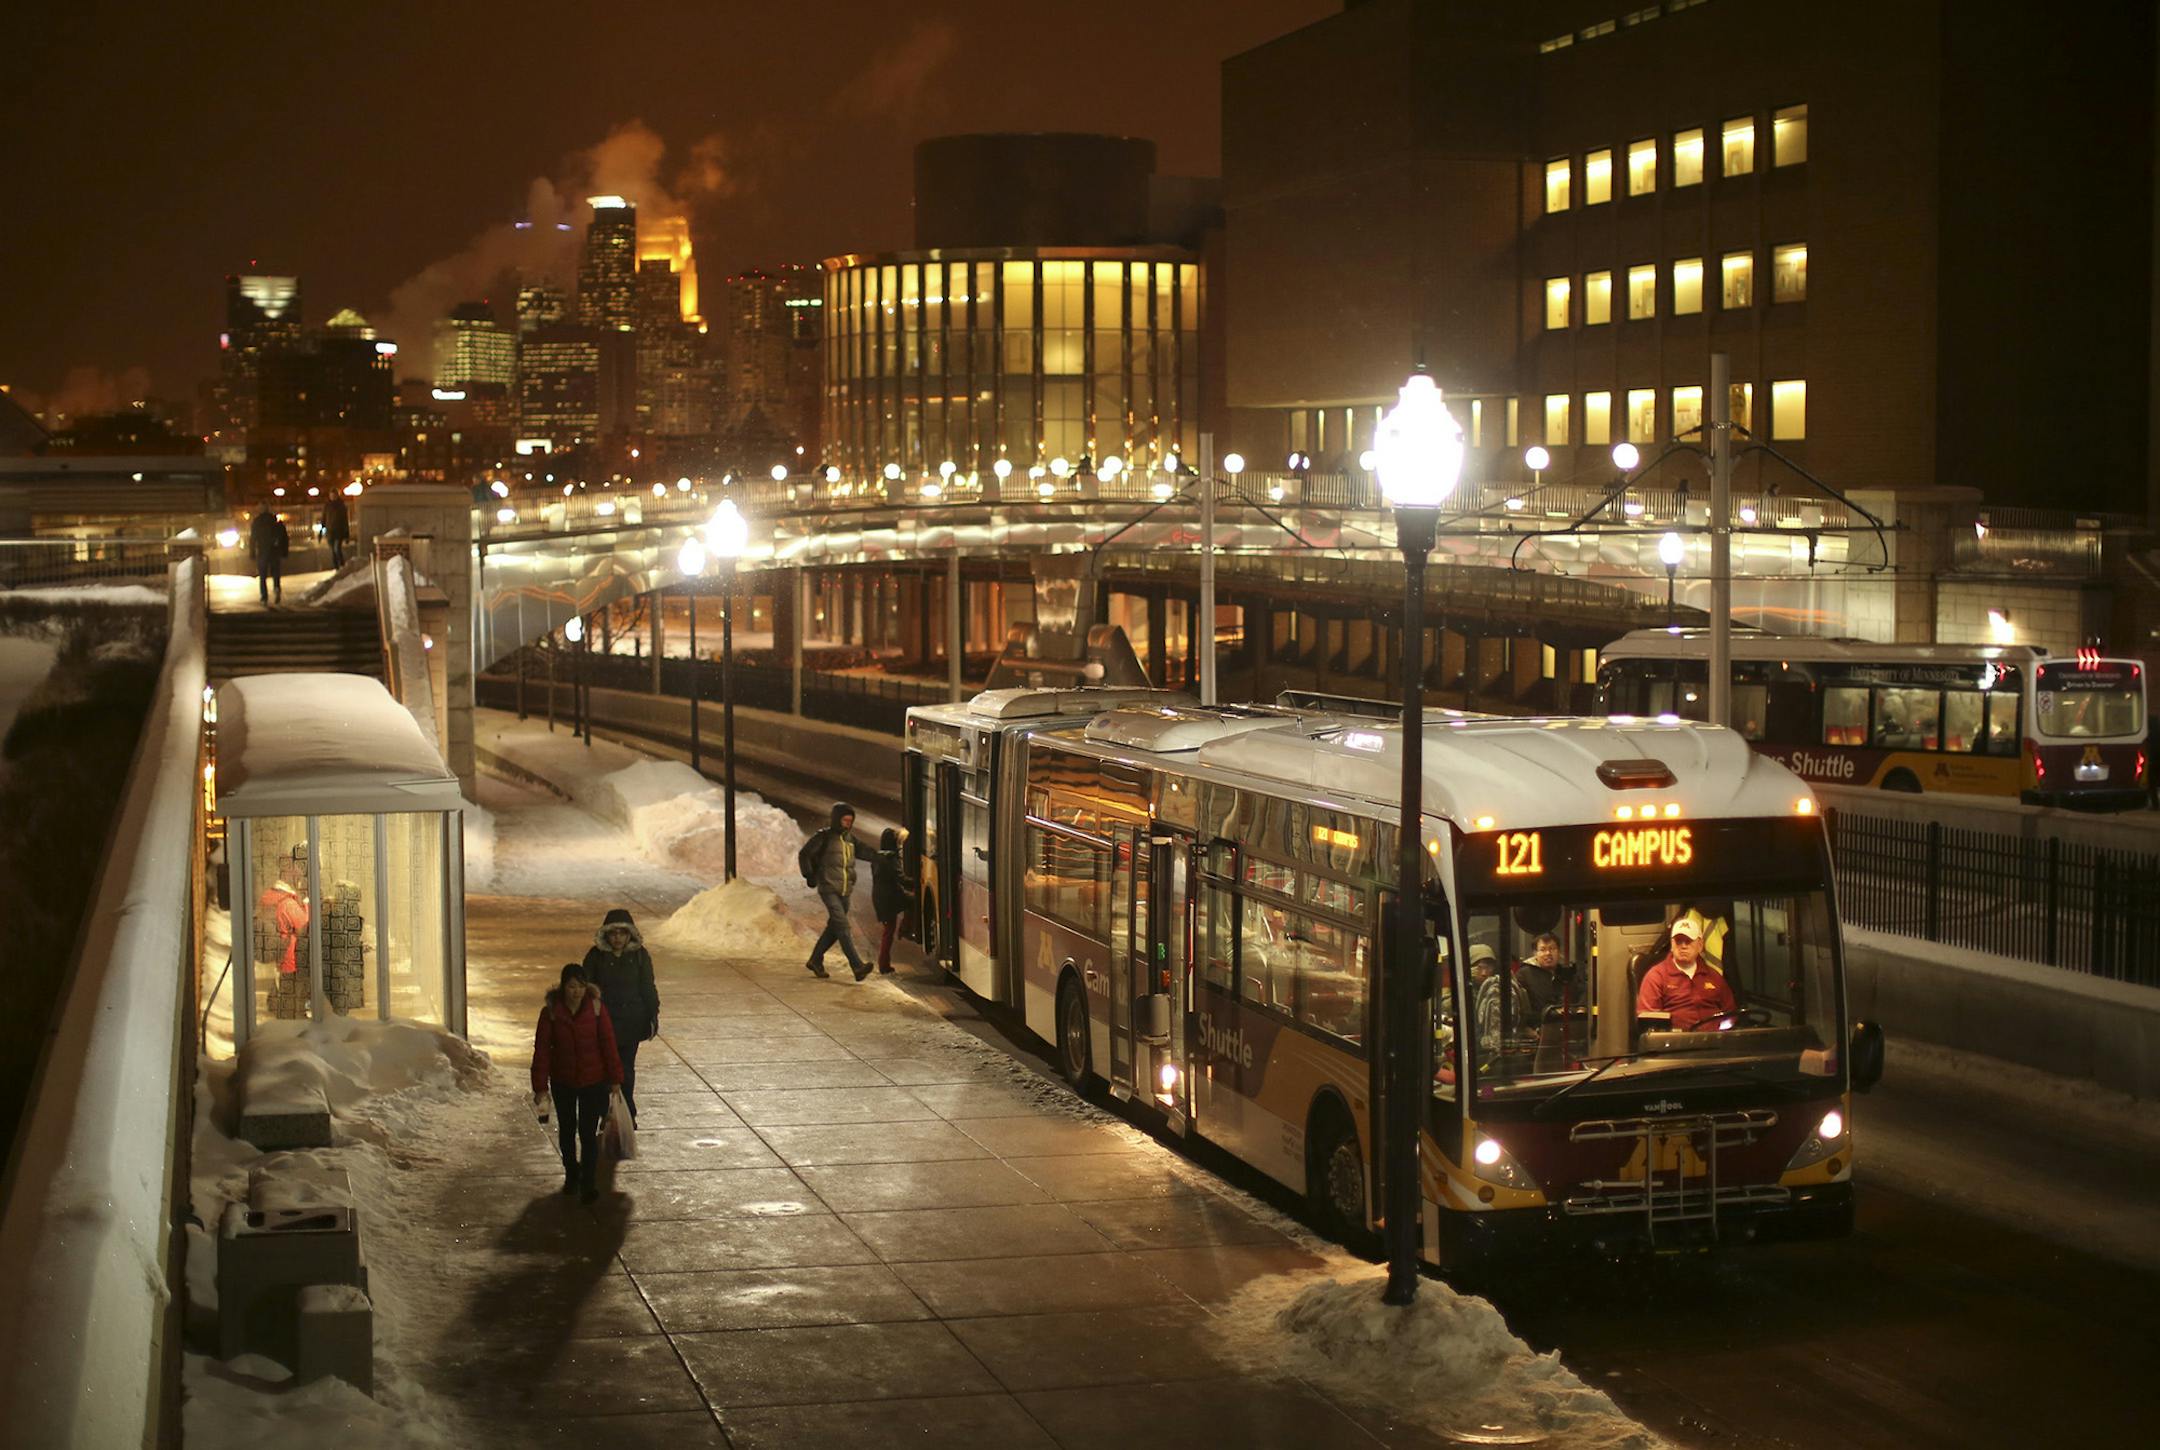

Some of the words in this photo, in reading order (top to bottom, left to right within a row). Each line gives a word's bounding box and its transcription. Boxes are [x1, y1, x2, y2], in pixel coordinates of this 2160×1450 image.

[1791, 751, 1855, 779] Shuttle
[1497, 832, 1543, 874] 121
[1593, 828, 1692, 868] CAMPUS
[1199, 1011, 1253, 1070] Shuttle
